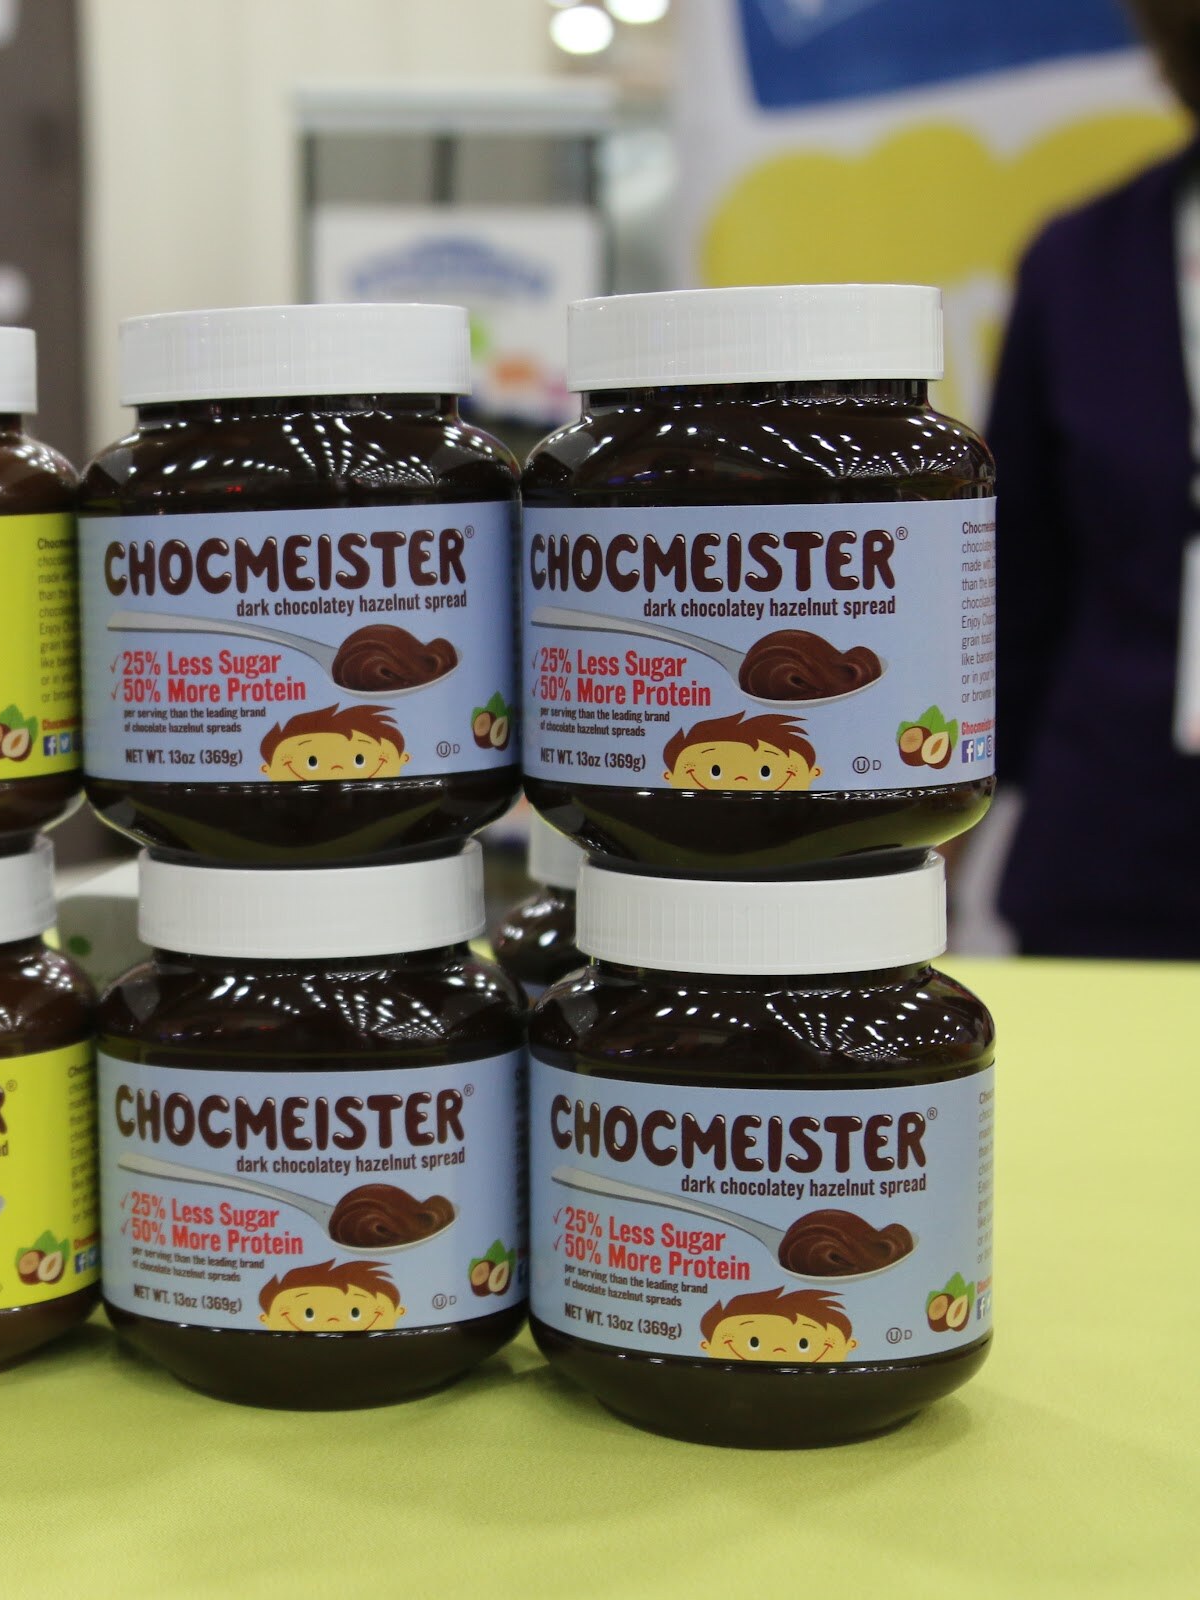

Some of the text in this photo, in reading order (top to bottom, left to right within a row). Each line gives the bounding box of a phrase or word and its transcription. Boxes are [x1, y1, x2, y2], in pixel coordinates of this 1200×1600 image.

[237, 590, 467, 617] dark chocolatey hazelnut spread
[644, 596, 896, 620] dark chocolatey hazelnut spread
[122, 650, 282, 679] 25% Less Sugar
[540, 648, 687, 682] 25% Less Sugar
[123, 676, 306, 703] 50% More Protein
[540, 675, 711, 707] 50% More Protein
[123, 707, 266, 720] per serving than the leading brand
[540, 707, 670, 723] per serving than the leading brand
[124, 723, 242, 735] of chocolate hazelnut spreads
[540, 720, 645, 738] of chocolate hazelnut spreads
[125, 749, 243, 767] NET WT. 13oz (369g)
[540, 747, 646, 772] NET WT. 13oz (369g)
[236, 1147, 466, 1176] dark chocolatey hazelnut spread
[681, 1174, 927, 1200] dark chocolatey hazelnut spread
[131, 1190, 280, 1232] 25% Less Sugar
[131, 1218, 304, 1255] 50% More Protein
[565, 1206, 726, 1255] 25% Less Sugar
[565, 1233, 751, 1281] 50% More Protein
[564, 1277, 682, 1307] of chocolate hazelnut spreads
[565, 1263, 708, 1294] per serving than the leading brand
[134, 1283, 242, 1315] NET WT. 13oz (369g)
[565, 1303, 682, 1340] NET WT. 13oz (369g)
